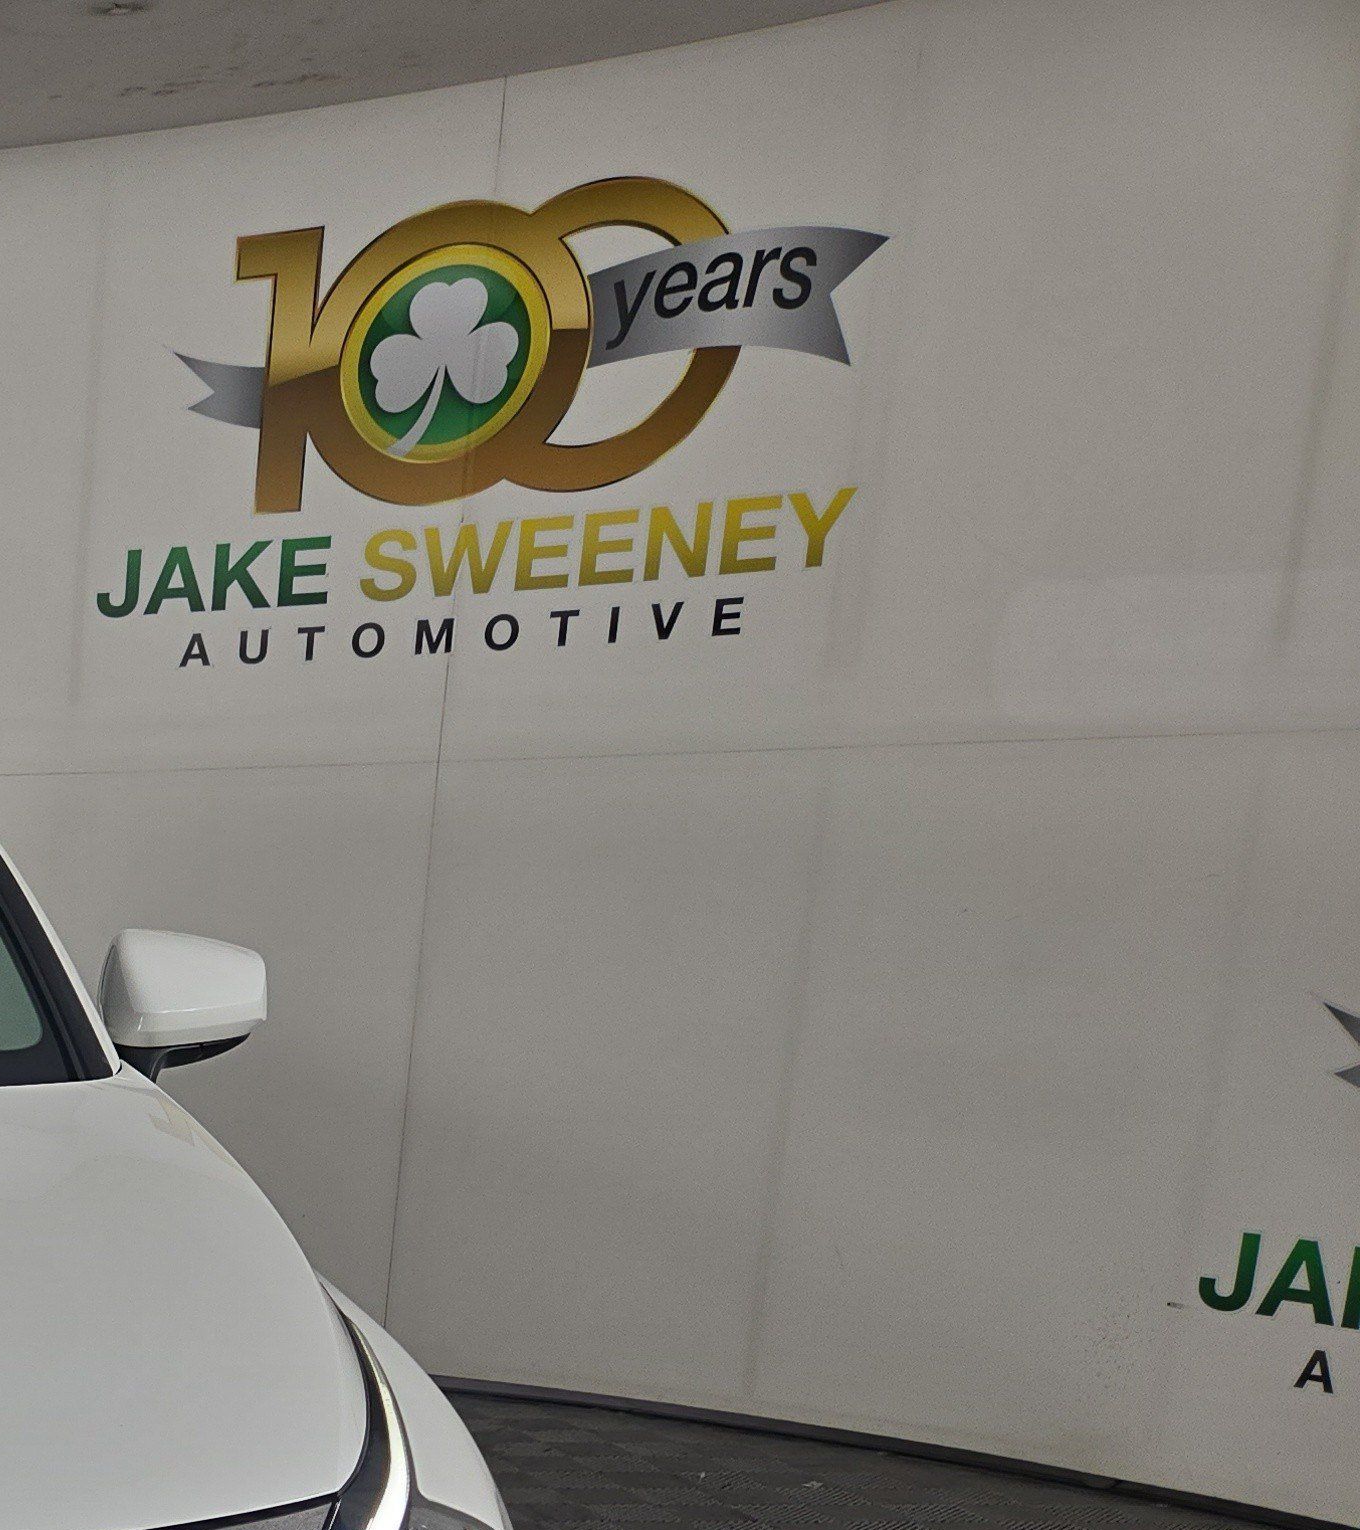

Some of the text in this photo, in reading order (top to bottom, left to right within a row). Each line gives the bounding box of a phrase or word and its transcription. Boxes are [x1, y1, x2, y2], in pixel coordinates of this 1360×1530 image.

[606, 245, 819, 350] years
[96, 487, 858, 618] JAKE SWEENEY
[179, 597, 745, 668] AUTOMOTIVE
